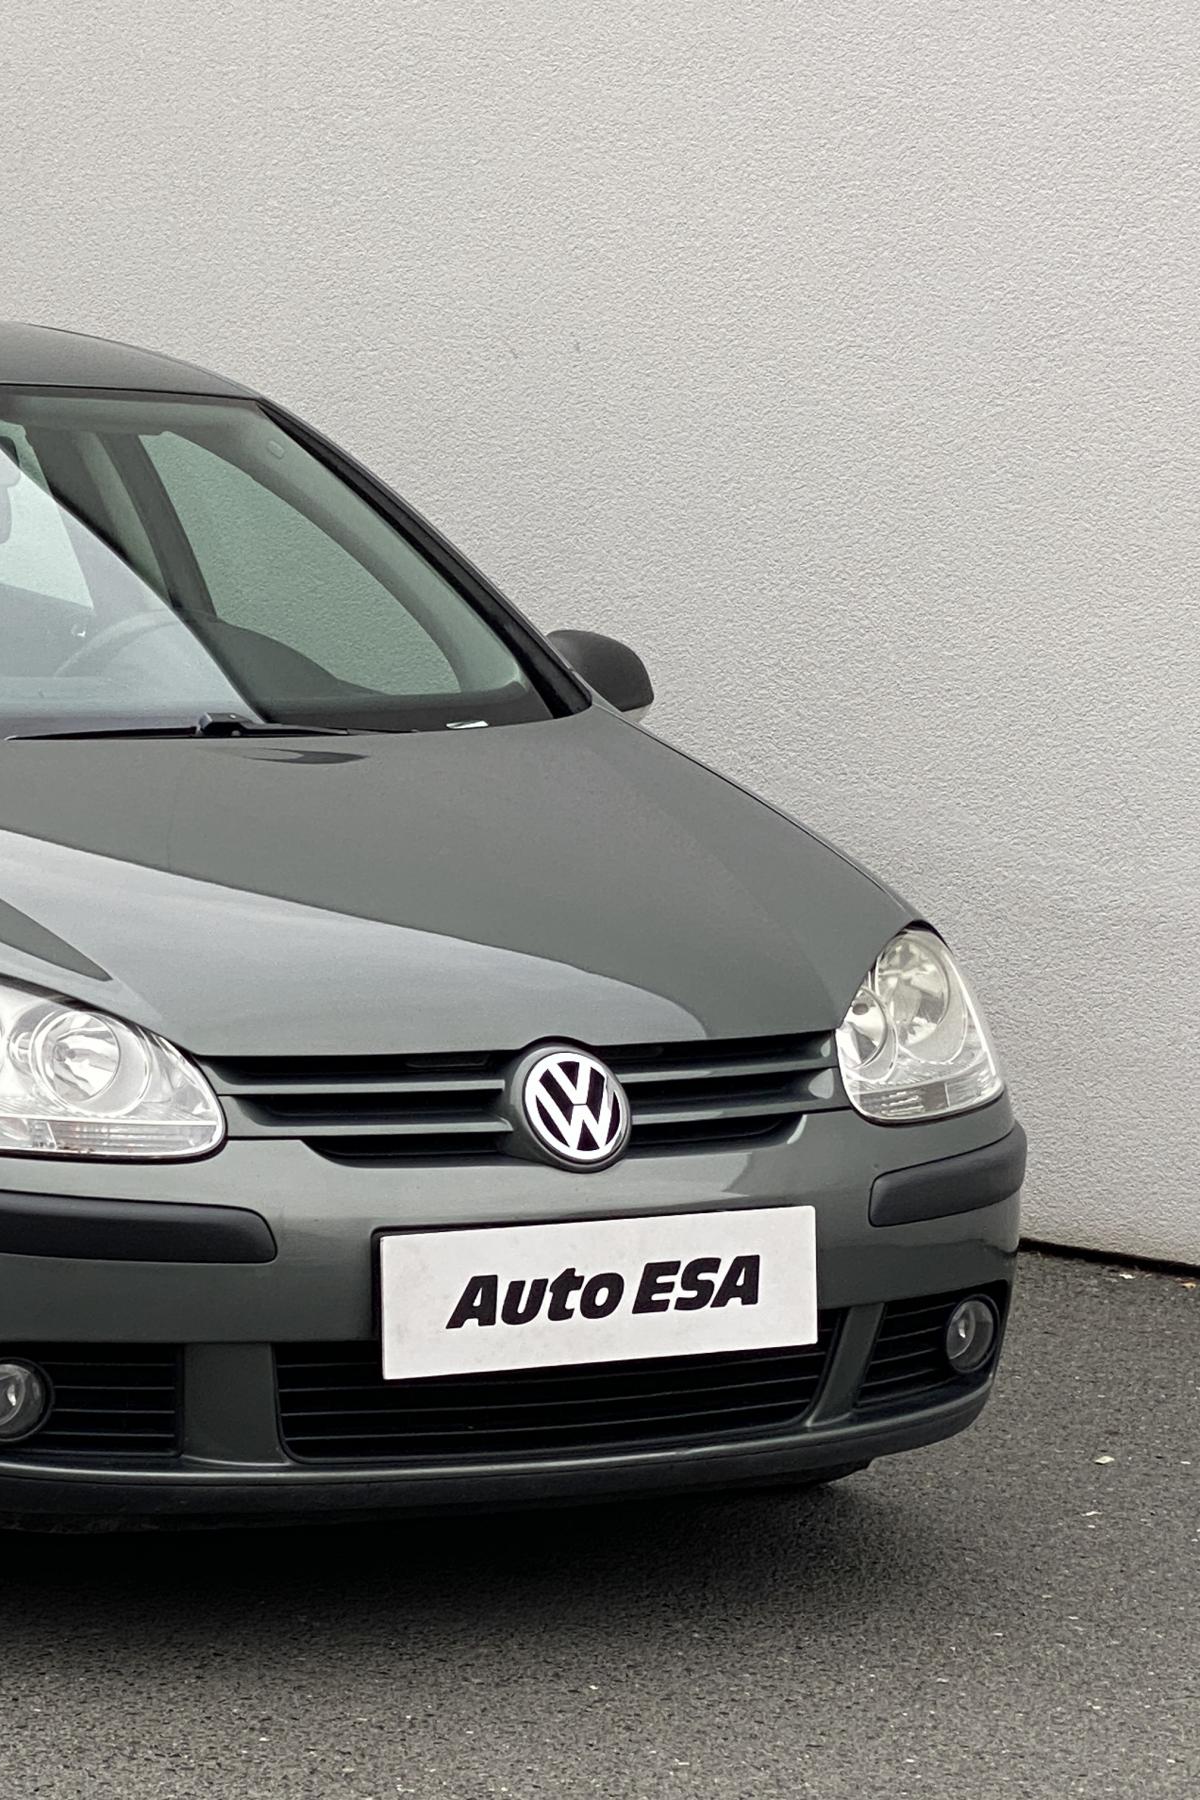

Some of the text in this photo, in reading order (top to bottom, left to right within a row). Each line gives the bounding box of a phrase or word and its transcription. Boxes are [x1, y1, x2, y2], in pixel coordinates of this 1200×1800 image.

[527, 1054, 620, 1158] VW
[445, 1254, 761, 1330] Auto ESA
